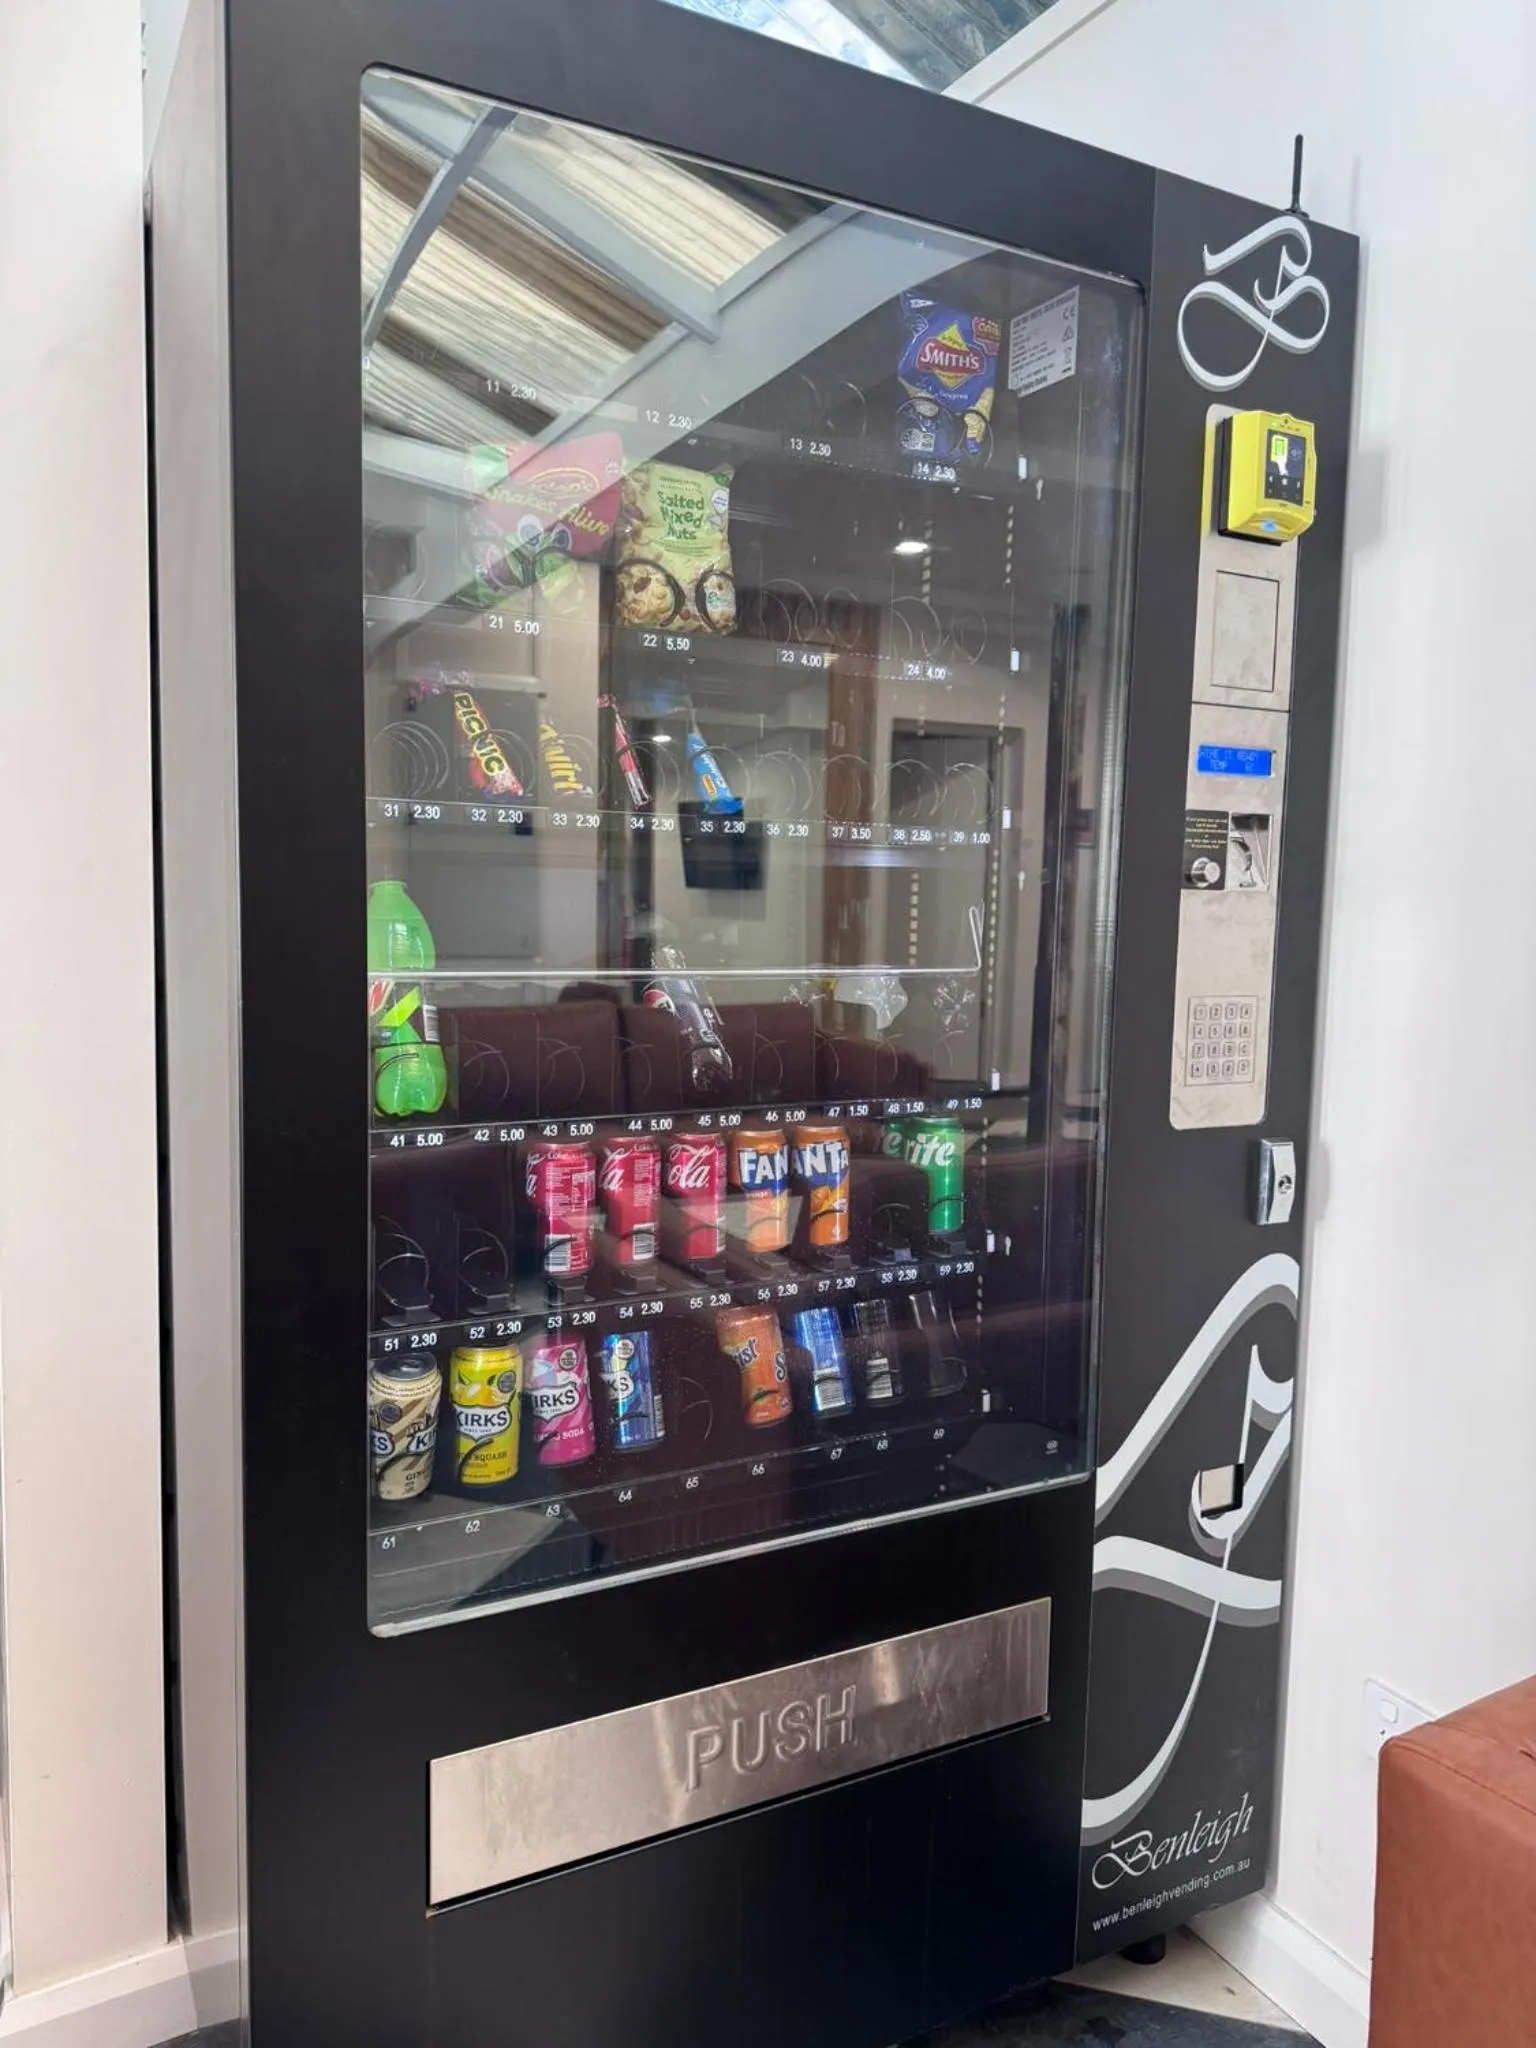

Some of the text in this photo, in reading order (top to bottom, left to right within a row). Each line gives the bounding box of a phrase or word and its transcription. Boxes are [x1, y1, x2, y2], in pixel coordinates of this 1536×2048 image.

[919, 343, 981, 370] SMITH'S
[486, 379, 537, 400] 11 2.30
[646, 410, 693, 429] 12 2.30
[790, 437, 832, 457] 13 2.30
[917, 461, 956, 480] 14 2.30
[657, 491, 705, 510] Salted
[660, 506, 704, 529] Mixed
[667, 523, 697, 540] Nuts
[489, 615, 540, 635] 21 5.00
[643, 634, 690, 651] 22 5.50
[781, 650, 823, 668] 23 4.00
[907, 663, 947, 681] 24 4.00
[454, 692, 509, 776] PICNIC
[384, 803, 440, 820] 31 2.30
[471, 808, 524, 824] 32 2.30
[552, 812, 600, 829] 33 2.30
[630, 816, 675, 832] 34 2.30
[700, 820, 747, 834] 35 2.30
[766, 823, 809, 838] 36 2.30
[832, 826, 871, 840] 37 3.50
[893, 829, 932, 843] 38 2.50
[953, 830, 991, 845] 39 1.00
[827, 1104, 869, 1118] 47 1.50
[888, 1101, 925, 1114] 48 1.50
[964, 1097, 983, 1109] 1.50
[628, 1118, 673, 1131] 44 5.00
[698, 1114, 741, 1127] 45 5.00
[765, 1110, 806, 1123] 46 5.00
[474, 1127, 525, 1142] 42 5.00
[543, 1122, 594, 1137] 43 5.00
[390, 1132, 444, 1148] 41 5.00
[905, 1132, 956, 1166] rite
[739, 1144, 789, 1184] FAN
[790, 1141, 849, 1177] ANTA
[898, 1268, 918, 1281] 2.30
[939, 1261, 975, 1276] 59 2.30
[757, 1283, 798, 1300] 56 2.30
[817, 1276, 856, 1292] 57 2.30
[689, 1293, 732, 1310] 55 2.30
[619, 1301, 664, 1319] 54 2.30
[547, 1311, 596, 1329] 53 2.30
[469, 1321, 522, 1339] 52 2.30
[384, 1333, 438, 1351] 51 2.30
[533, 1389, 576, 1408] IRKS
[456, 1409, 507, 1427] KIRKS
[562, 1428, 585, 1440] SODA
[932, 1427, 945, 1440] 69
[876, 1438, 889, 1451] 68
[829, 1447, 843, 1460] 67
[751, 1463, 766, 1476] 66
[686, 1476, 700, 1489] 65
[618, 1489, 632, 1502] 64
[545, 1504, 561, 1517] 63
[465, 1520, 481, 1534] 62
[382, 1536, 396, 1549] 61
[684, 1684, 858, 1792] PUSH
[1091, 1792, 1254, 1889] Benleigh
[1092, 1857, 1251, 1932] www.benleighvending.com.au
